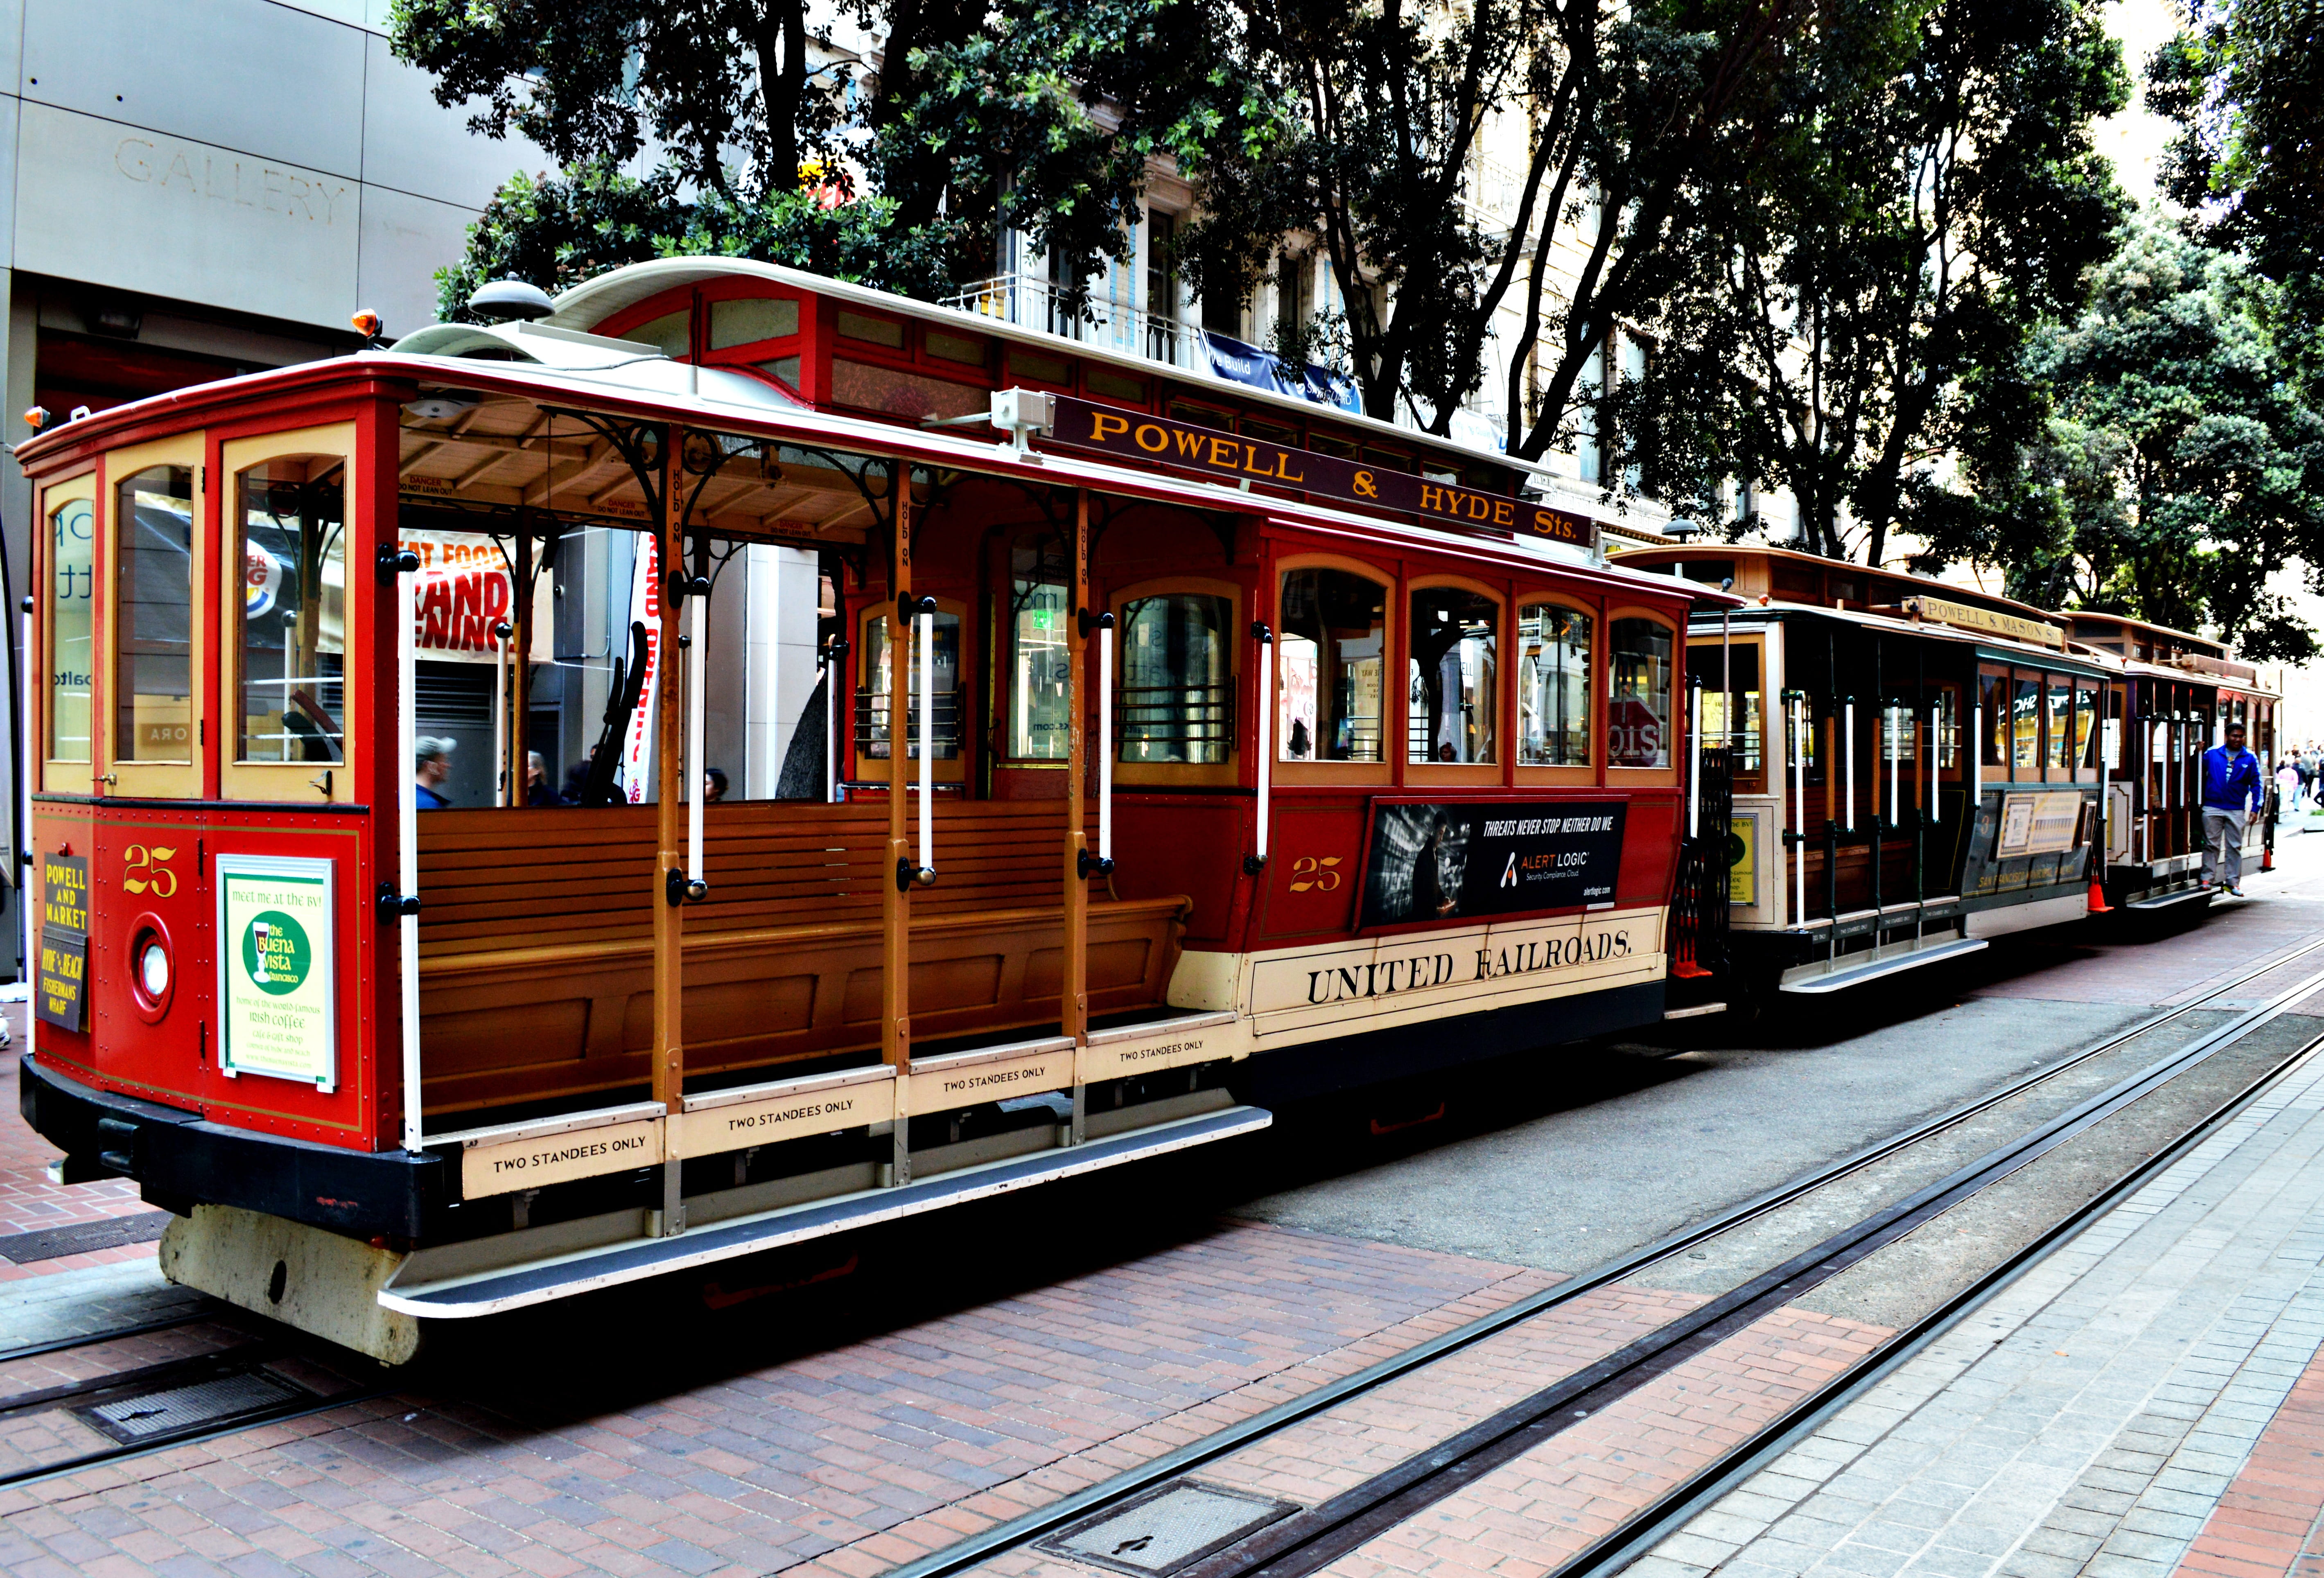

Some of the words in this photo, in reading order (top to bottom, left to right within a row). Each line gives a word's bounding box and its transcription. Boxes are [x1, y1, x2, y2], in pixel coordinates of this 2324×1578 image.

[116, 138, 345, 224] GALLERY
[1224, 356, 1251, 375] Build
[410, 476, 441, 486] DANGER
[1090, 411, 1304, 483] POWELL
[1353, 471, 1378, 498] &
[1421, 485, 1514, 526] HYDE
[1534, 512, 1577, 540] Sts.
[423, 486, 439, 494] LEAN
[608, 499, 635, 509] DANGER
[673, 522, 680, 543] ON
[903, 548, 908, 567] ON
[1082, 569, 1086, 585] ON
[1928, 602, 1983, 625] POWELL
[1989, 614, 1997, 628] &
[2003, 617, 2042, 637] MASON
[1484, 820, 1517, 837] THREATS
[1517, 819, 1541, 835] NEVER
[1541, 819, 1561, 834] STOP.
[1561, 817, 1591, 833] NEITHER
[1590, 817, 1601, 831] DO
[1602, 817, 1613, 831] WE.
[123, 844, 177, 898] 25
[1521, 854, 1556, 869] ALERT
[46, 864, 86, 890] POWELL
[1290, 856, 1343, 892] 25
[56, 889, 76, 906] AND
[1584, 887, 1610, 896] alertlogic.com
[46, 903, 86, 930] MARKET
[269, 924, 284, 937] the
[42, 948, 56, 973] HYDE
[61, 952, 83, 981] BEACH
[1307, 954, 1453, 1004] UNITED
[1475, 930, 1632, 980] RAILROADS.
[43, 976, 76, 1001] FISHERMANS
[49, 997, 67, 1016] WHARF
[1120, 1051, 1138, 1062] TWO
[1141, 1044, 1182, 1059] STANDEES
[1184, 1040, 1204, 1051] ONLY
[944, 1080, 965, 1092] TWO
[969, 1071, 1019, 1088] STANDEES
[1022, 1067, 1045, 1079] ONLY
[729, 1117, 755, 1131] TWO
[759, 1105, 821, 1125] STANDEES
[825, 1100, 853, 1113] ONLY
[494, 1158, 526, 1173] TWO
[532, 1143, 607, 1167] STANDEES
[612, 1136, 646, 1151] ONLY
